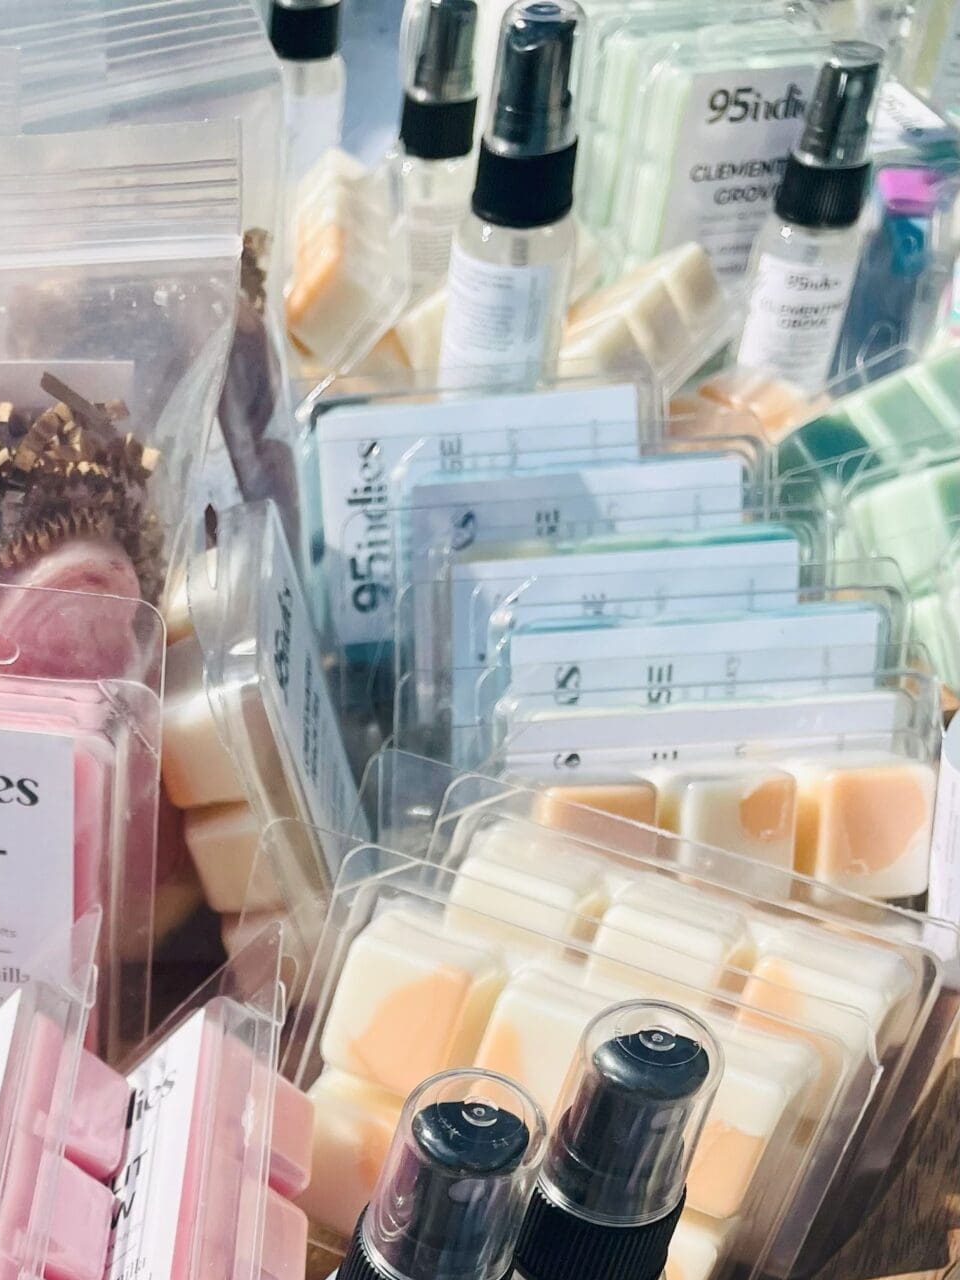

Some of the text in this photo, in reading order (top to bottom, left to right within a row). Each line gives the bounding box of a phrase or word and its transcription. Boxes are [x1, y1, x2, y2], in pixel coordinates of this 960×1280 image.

[706, 82, 807, 123] 95indi
[691, 157, 789, 183] CLEMENT
[713, 183, 778, 205] GROV
